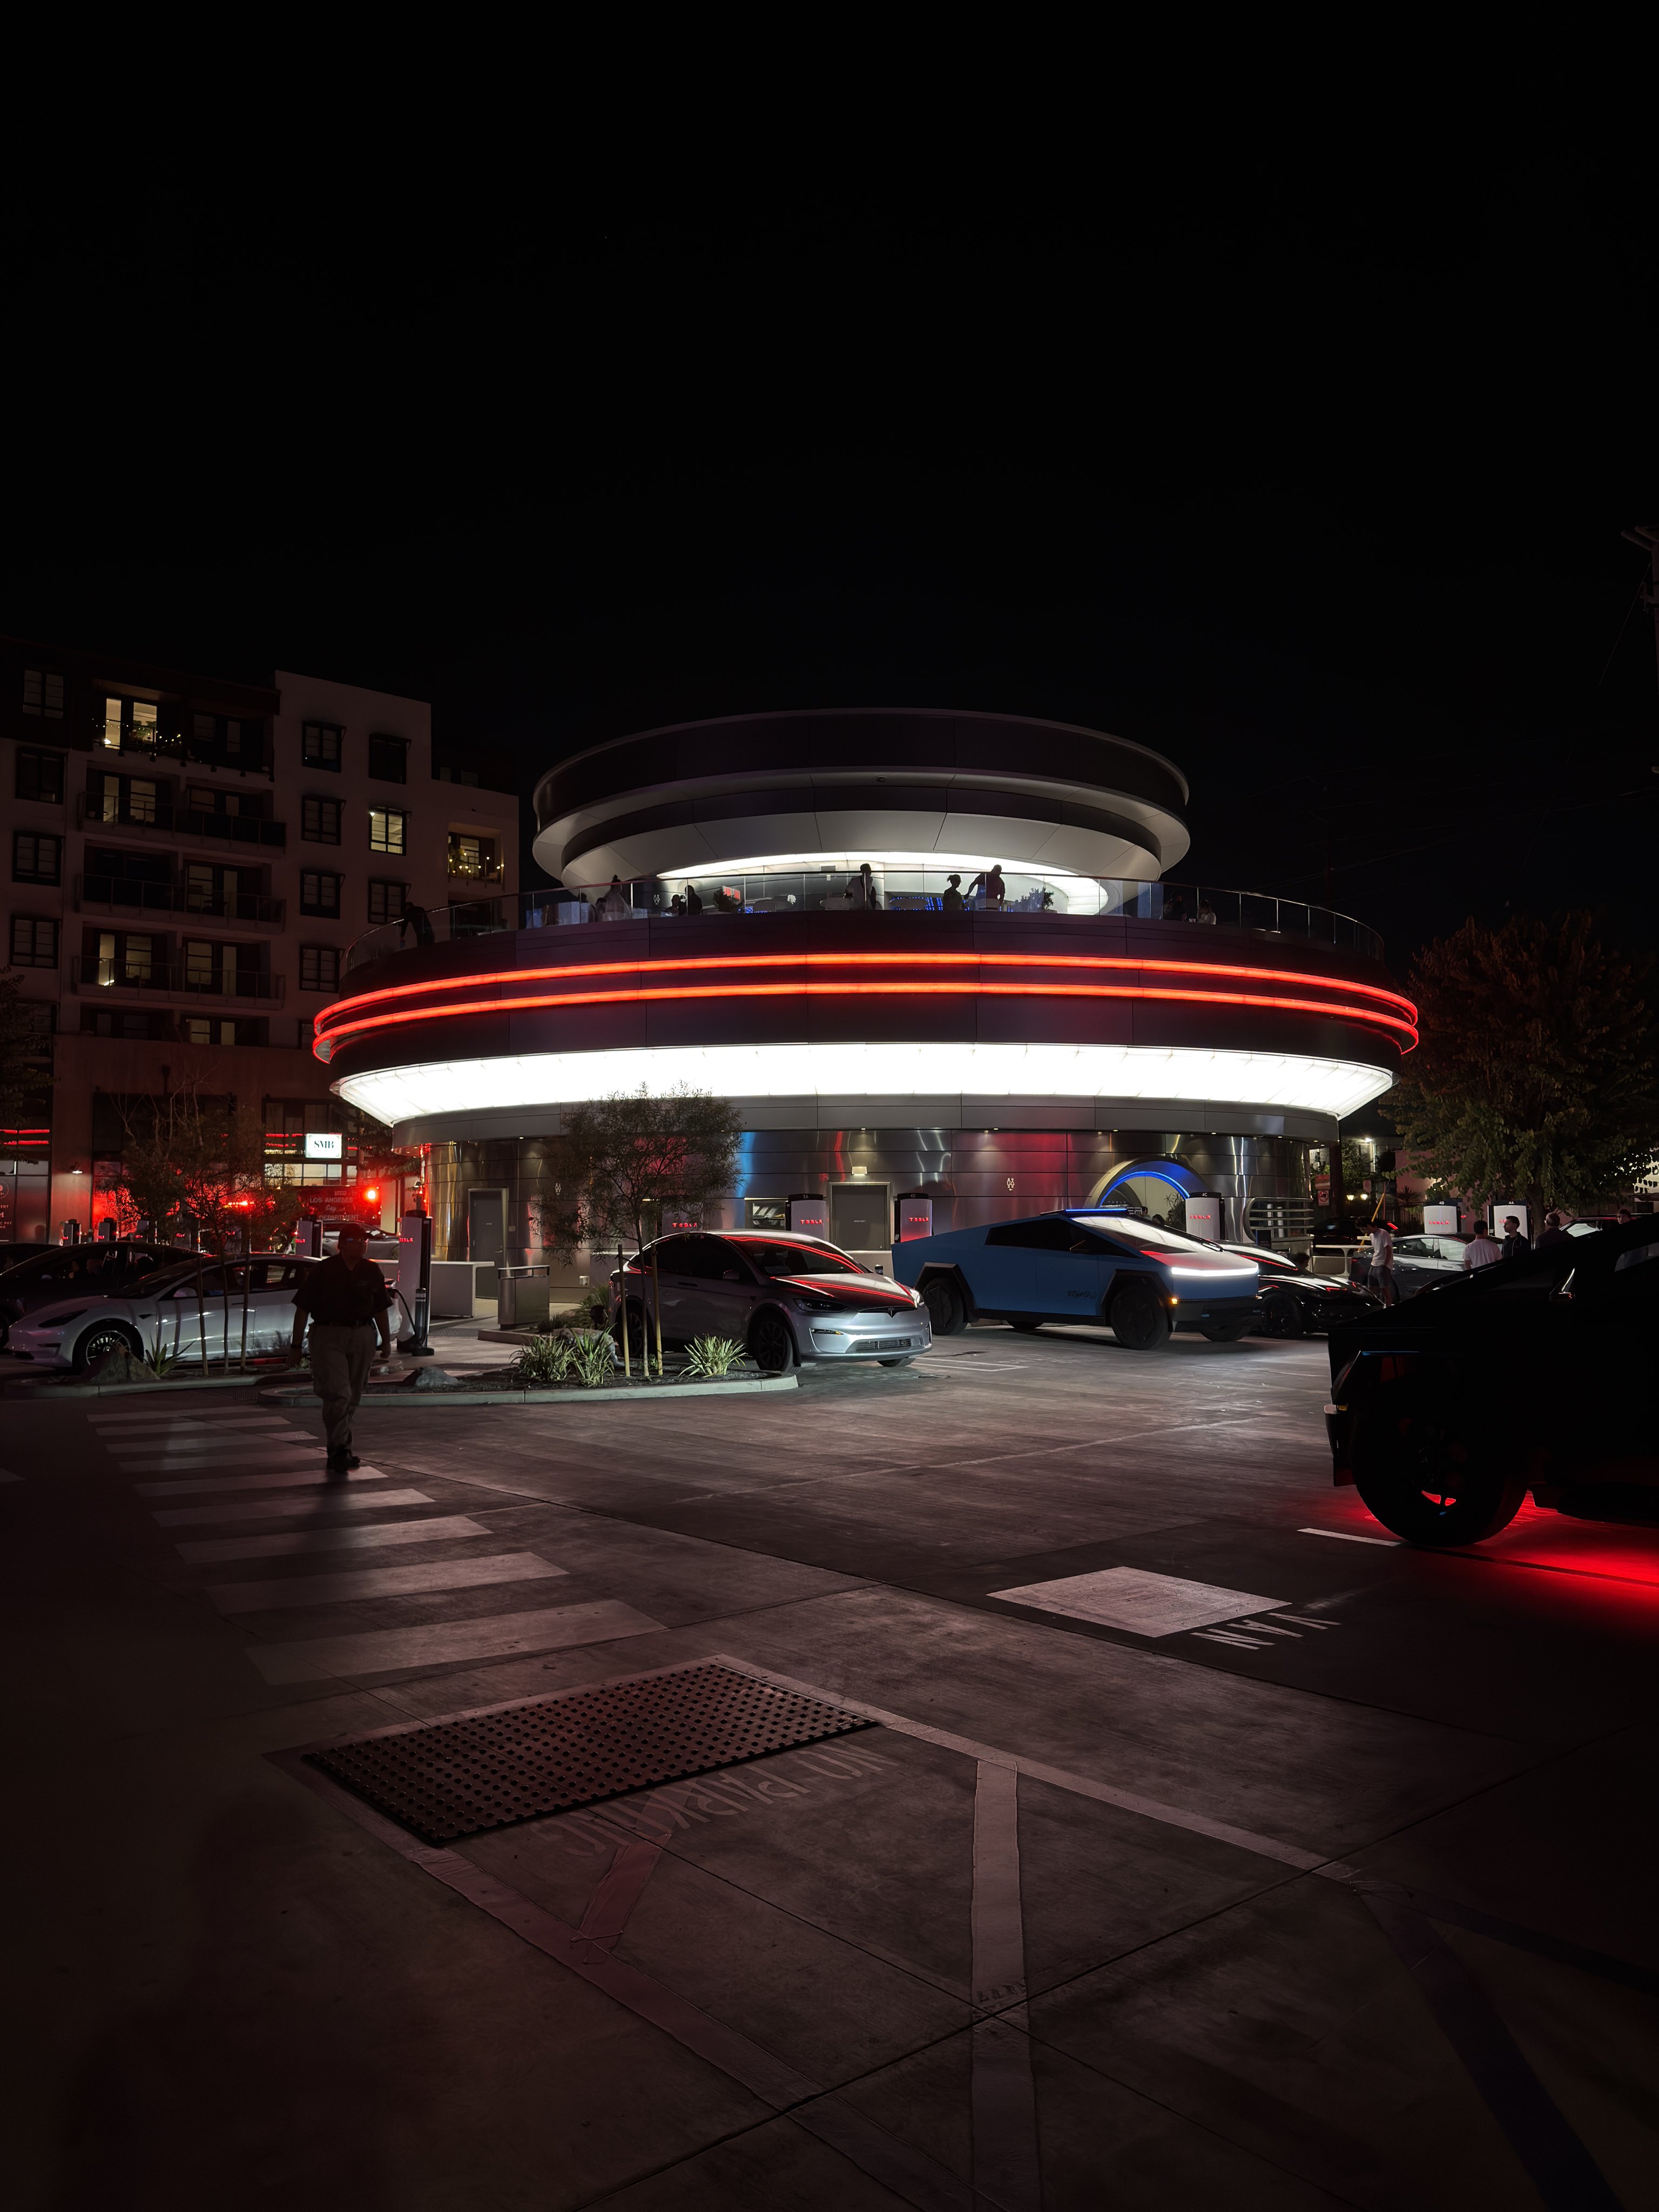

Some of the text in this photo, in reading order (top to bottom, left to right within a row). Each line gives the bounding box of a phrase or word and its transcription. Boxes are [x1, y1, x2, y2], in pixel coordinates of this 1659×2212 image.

[314, 1140, 334, 1149] SMB
[1190, 1612, 1343, 1650] VAN
[528, 1740, 900, 1857] NO PARKING
